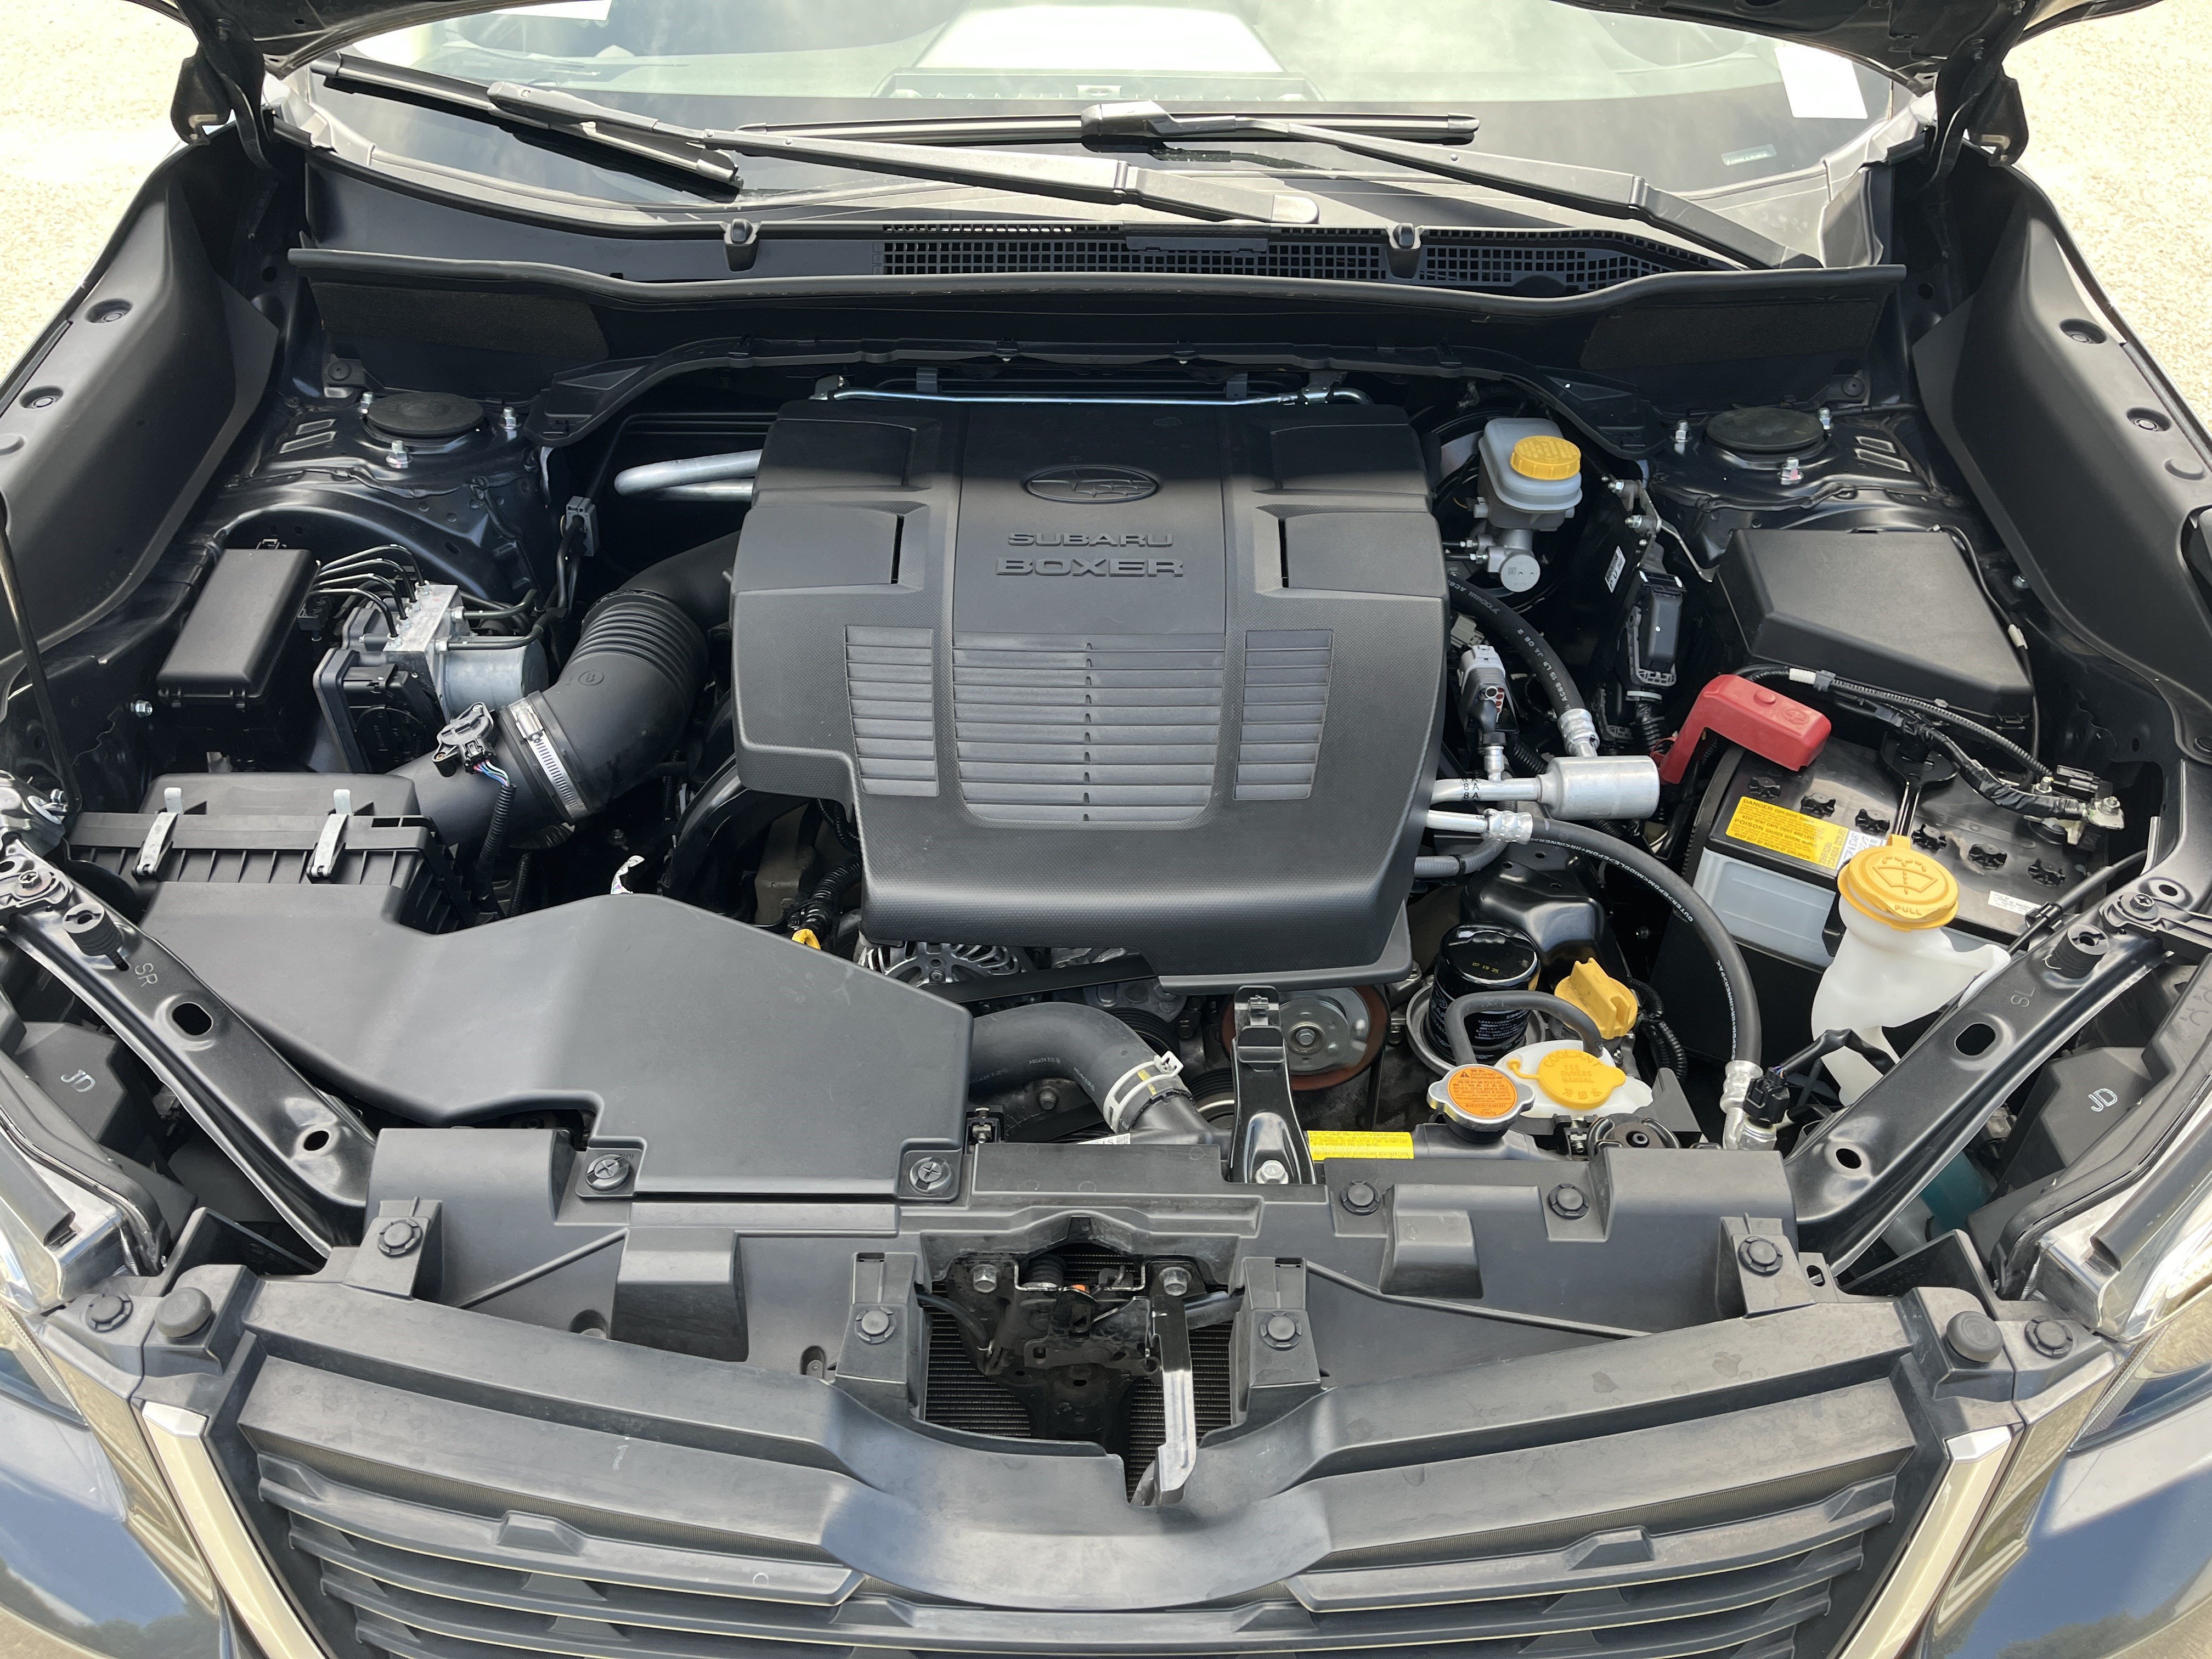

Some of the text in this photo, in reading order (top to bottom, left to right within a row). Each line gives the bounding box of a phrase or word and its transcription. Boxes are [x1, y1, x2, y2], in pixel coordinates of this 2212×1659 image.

[1008, 532, 1173, 548] SUBARU
[996, 557, 1184, 577] BOXER
[1743, 799, 1773, 811] DANGER
[1775, 809, 1798, 819] EXPLOSIVE
[1734, 818, 1764, 831] POISON
[1765, 828, 1783, 837] CAUSES
[1787, 849, 1810, 860] CHILDREN
[1894, 904, 1923, 916] PULL
[134, 962, 158, 987] SR
[2010, 987, 2037, 1008] SL
[1543, 1050, 1603, 1068] COOLANT
[60, 1069, 97, 1093] JD
[2087, 1088, 2118, 1113] JD
